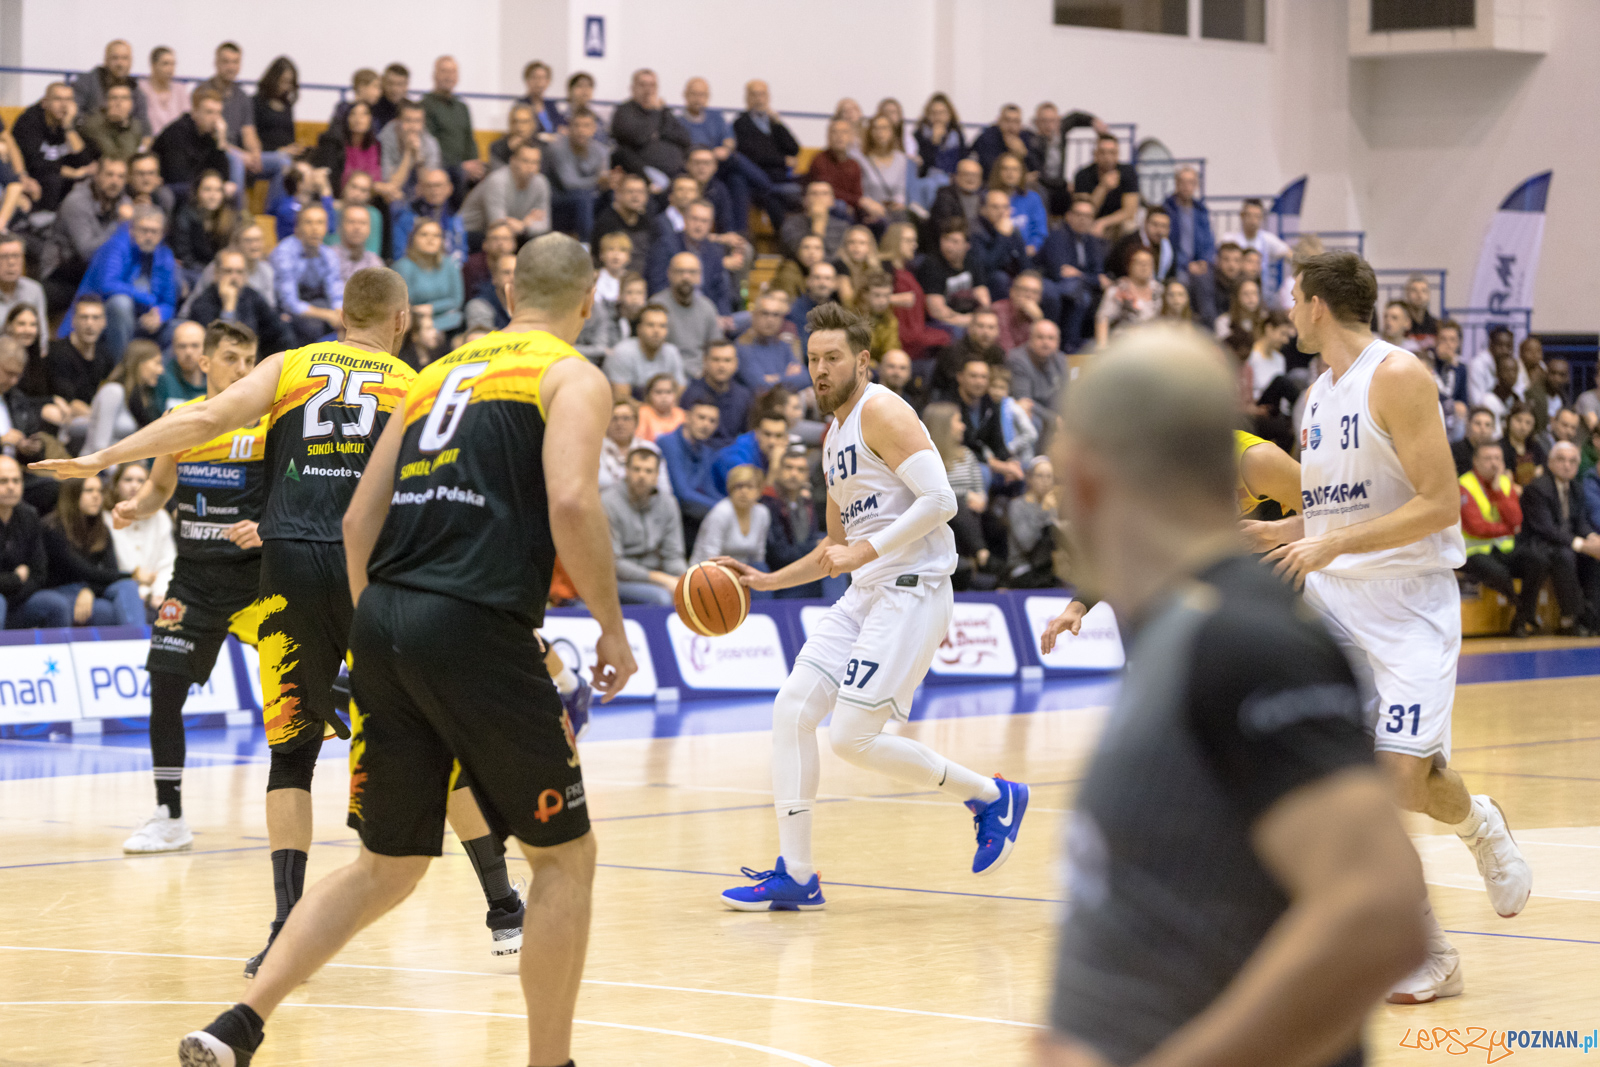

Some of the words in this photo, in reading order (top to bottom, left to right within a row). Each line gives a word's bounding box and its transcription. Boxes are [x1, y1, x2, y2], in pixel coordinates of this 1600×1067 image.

[310, 352, 394, 374] CIECHOCIŃSKI
[303, 363, 385, 441] 25
[418, 360, 491, 455] 6
[228, 434, 256, 459] 10
[1340, 413, 1360, 451] 31
[302, 464, 353, 478] Anocote
[837, 443, 858, 480] 97
[843, 658, 880, 689] 97
[1385, 703, 1422, 736] 31
